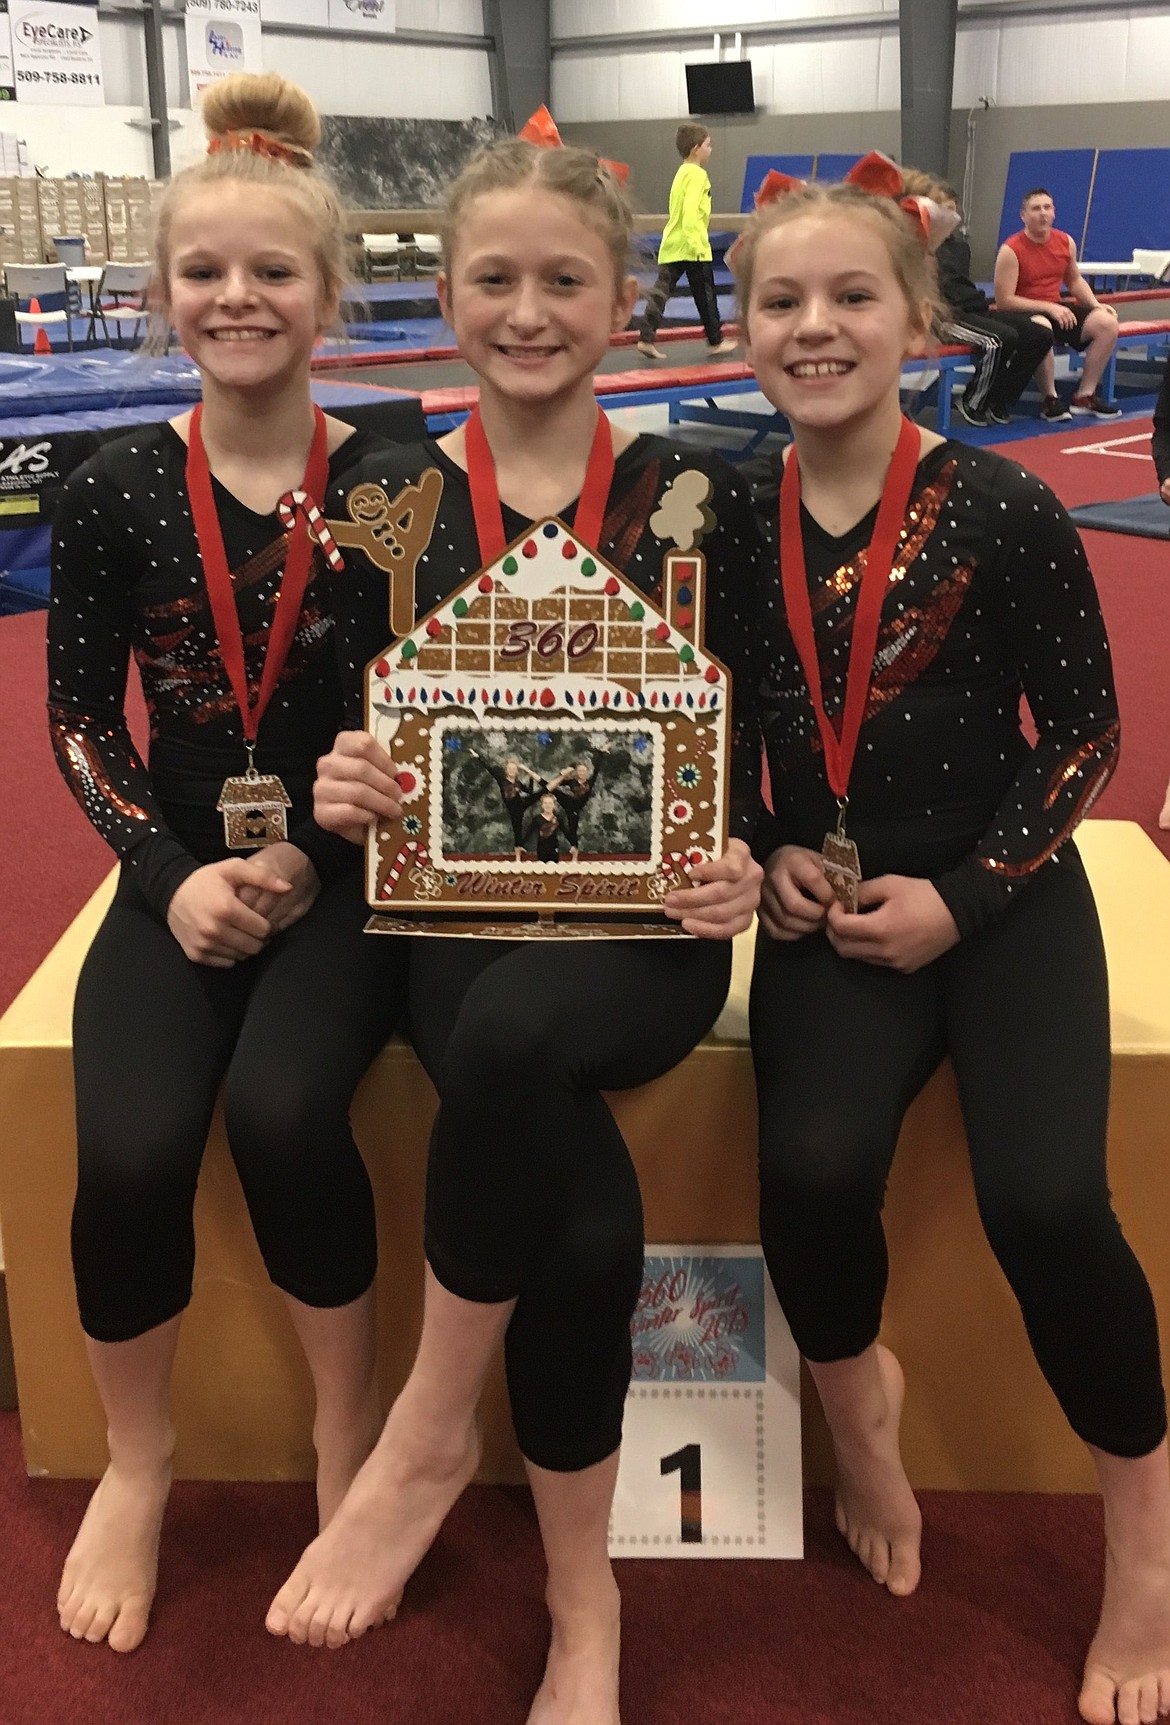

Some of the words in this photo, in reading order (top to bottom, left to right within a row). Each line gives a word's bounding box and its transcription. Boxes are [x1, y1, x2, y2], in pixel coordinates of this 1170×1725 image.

[22, 21, 79, 43] EyeCare
[16, 70, 100, 85] 509-758-8811
[500, 621, 599, 659] 360
[457, 871, 546, 897] Winter
[555, 873, 640, 904] Spirit
[660, 1444, 702, 1543] 1
